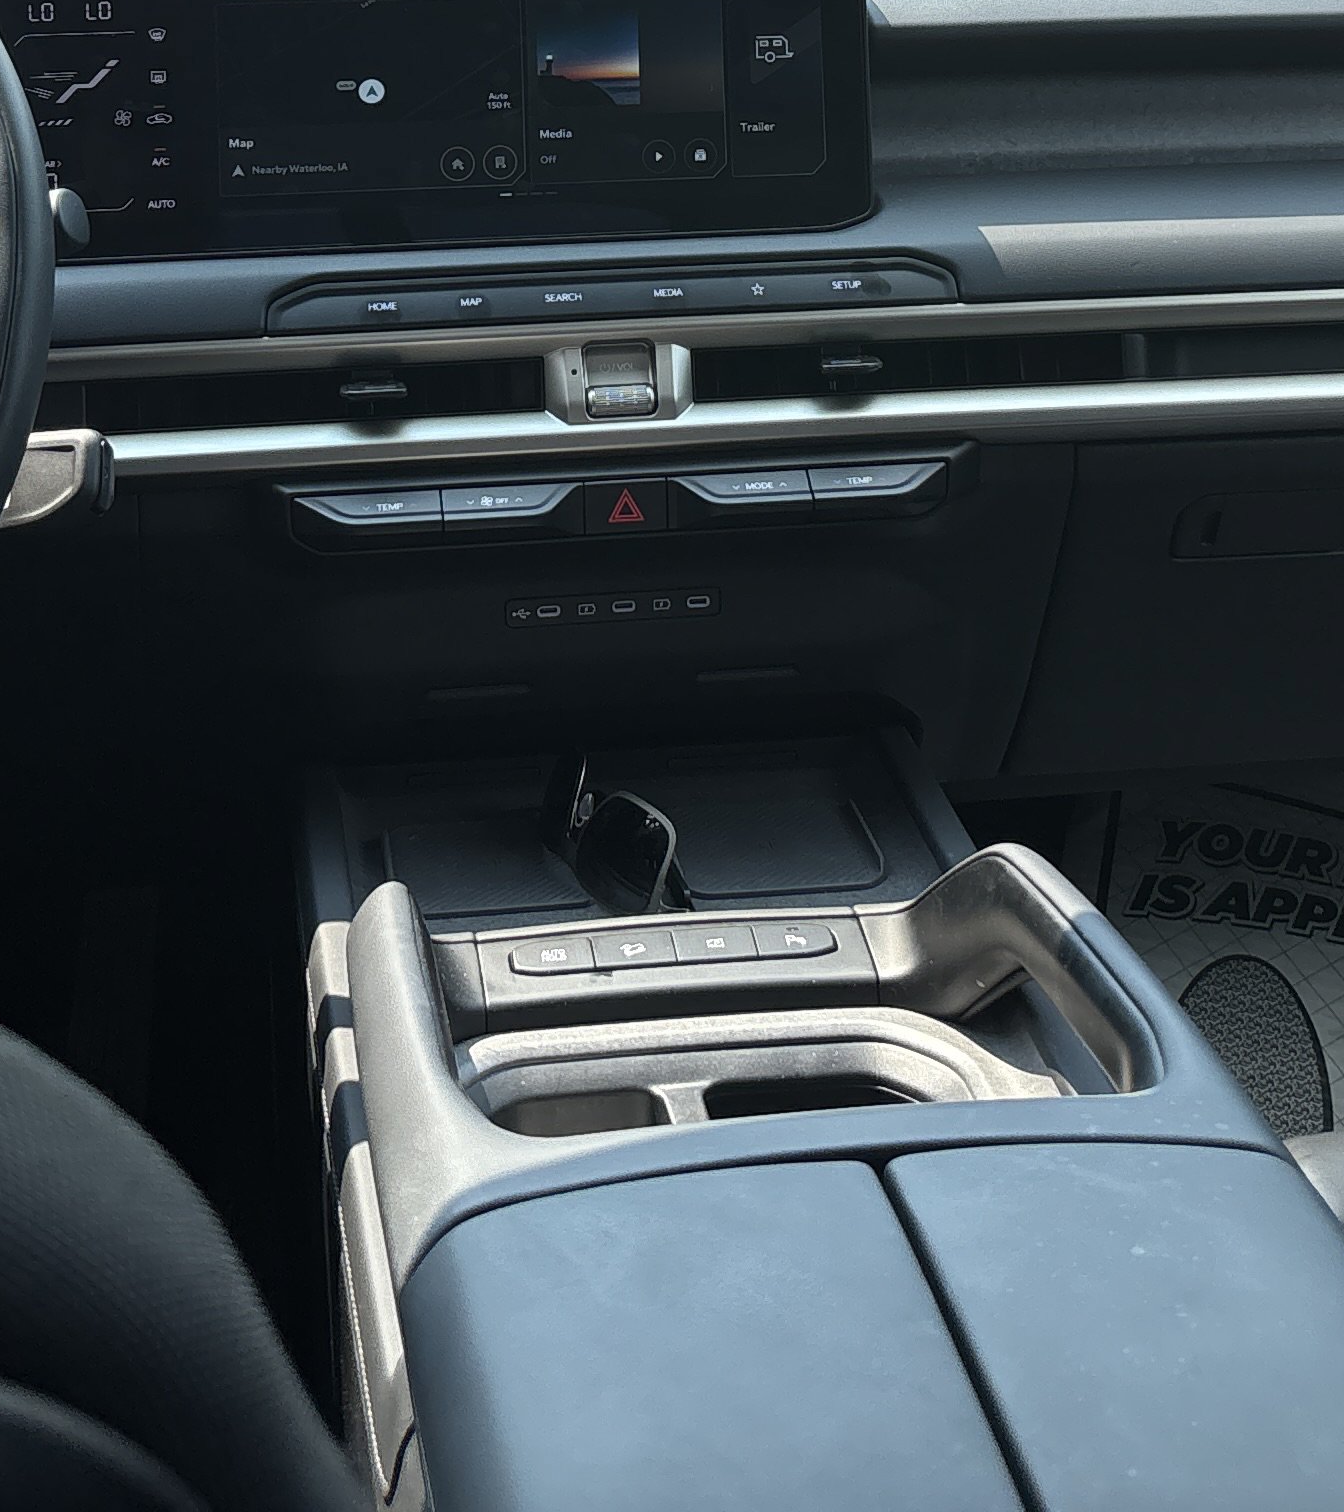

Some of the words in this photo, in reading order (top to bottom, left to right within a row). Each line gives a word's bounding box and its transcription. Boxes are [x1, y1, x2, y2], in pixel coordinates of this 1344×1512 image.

[488, 92, 509, 100] Auto
[487, 101, 502, 109] 150
[503, 101, 511, 109] ft
[739, 121, 776, 133] Trailer
[539, 128, 573, 139] Media
[228, 138, 254, 150] Map
[151, 157, 170, 167] A/C
[540, 155, 557, 164] Off
[251, 165, 288, 176] Nearby
[288, 163, 336, 174] Waterloo,
[337, 162, 349, 172] IA
[147, 199, 176, 209] AUTO
[831, 280, 862, 290] SETUP
[544, 292, 583, 303] SEARCH
[653, 287, 684, 298] MEDIA
[367, 301, 398, 312] HOME
[460, 297, 483, 307] MAP
[846, 476, 873, 485] TEMP
[744, 482, 774, 490] MODE
[376, 503, 403, 512] TEMP
[1159, 821, 1339, 881] YOUR
[1124, 872, 1203, 919] IS
